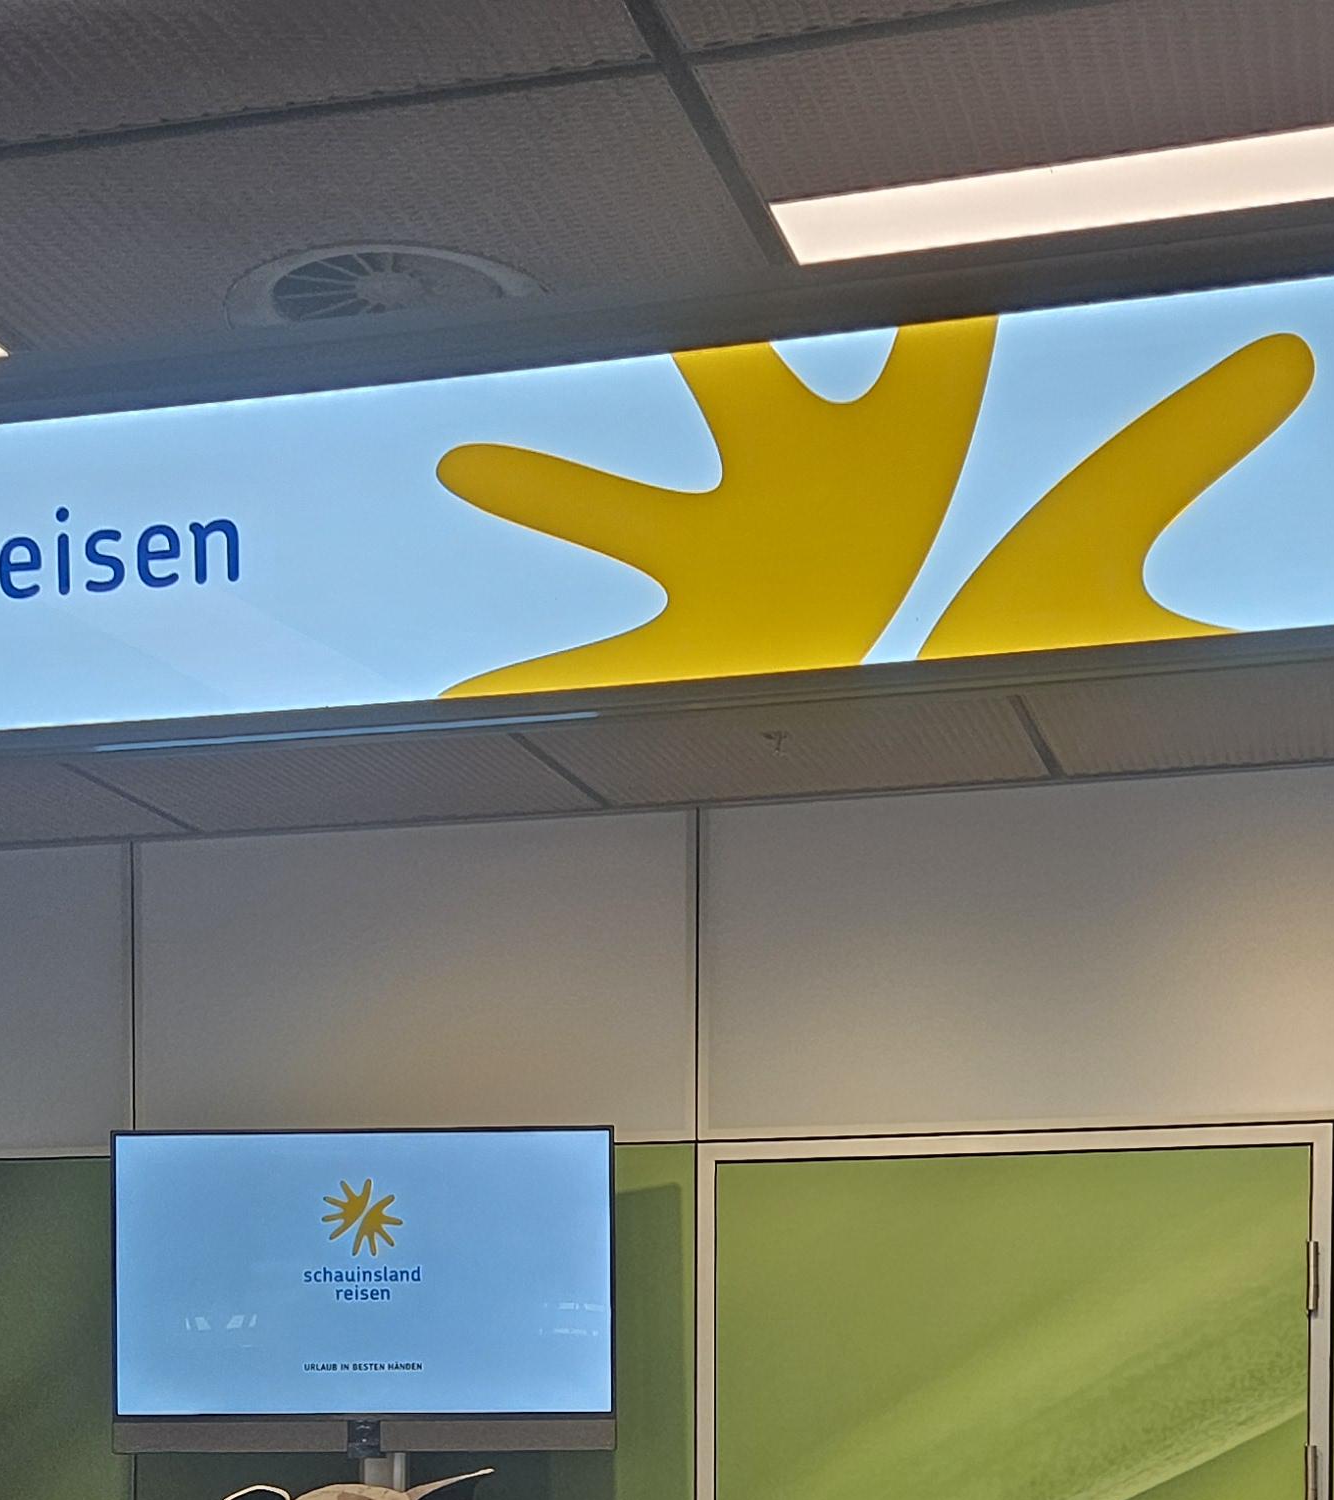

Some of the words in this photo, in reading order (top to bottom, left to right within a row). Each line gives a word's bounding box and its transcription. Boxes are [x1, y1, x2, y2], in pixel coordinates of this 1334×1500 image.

[303, 1266, 421, 1283] schauinsland
[336, 1285, 391, 1301] reisen
[388, 1362, 422, 1370] HÄNDEN
